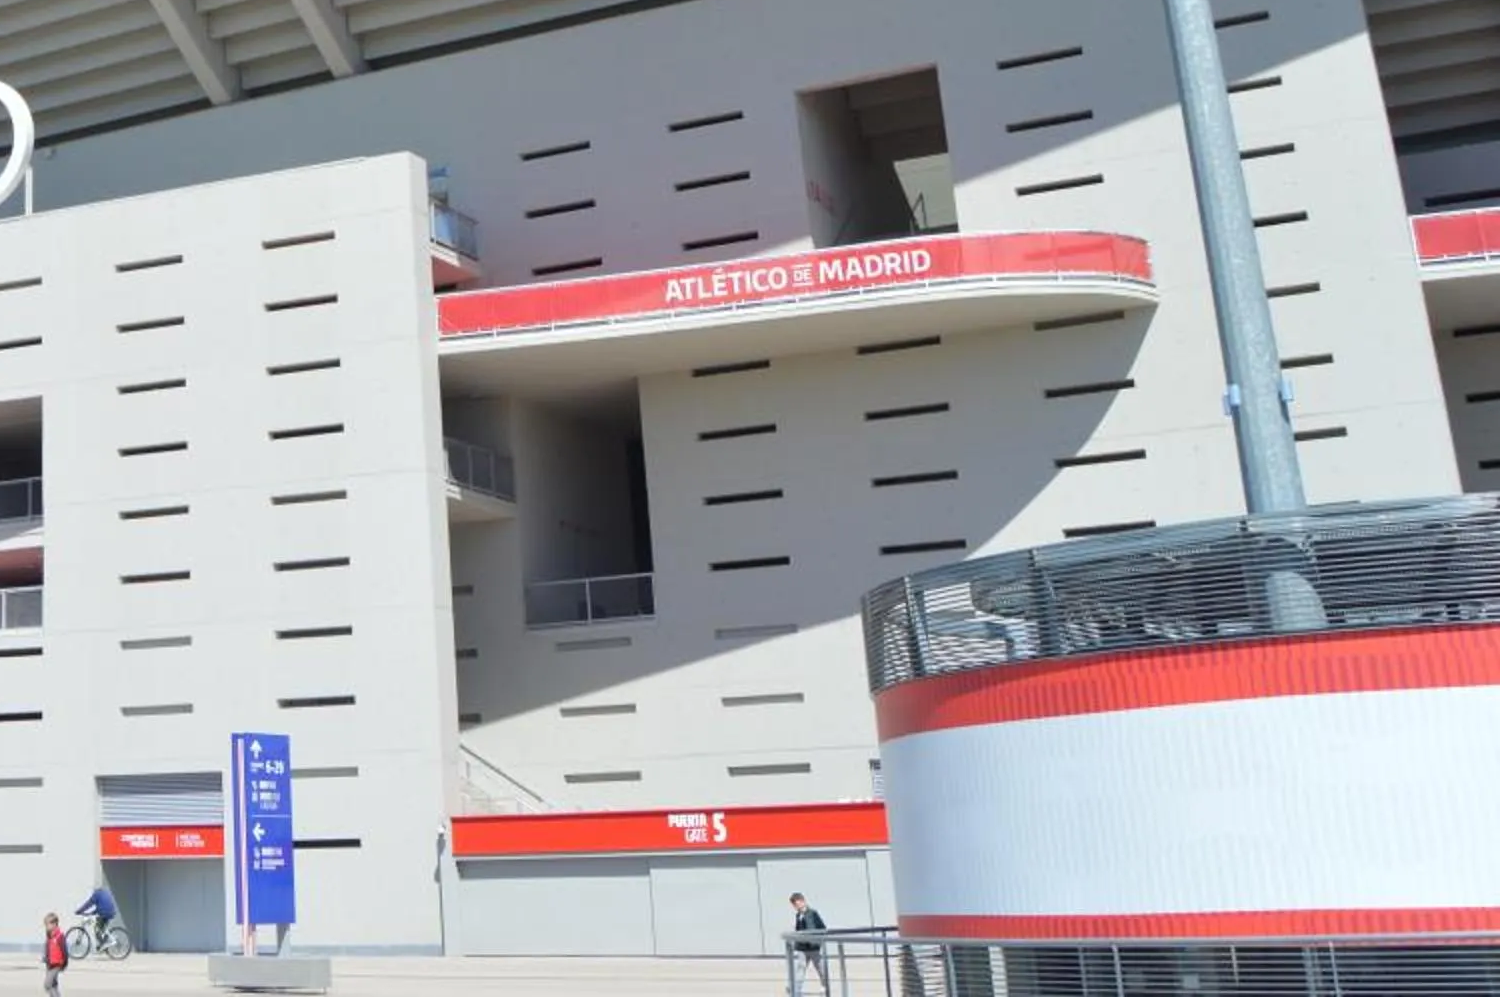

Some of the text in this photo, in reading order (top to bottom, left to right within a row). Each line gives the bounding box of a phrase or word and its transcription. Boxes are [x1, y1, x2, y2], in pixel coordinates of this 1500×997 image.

[665, 249, 932, 302] ATLÉTICO DE MADRID
[712, 811, 728, 843] 5
